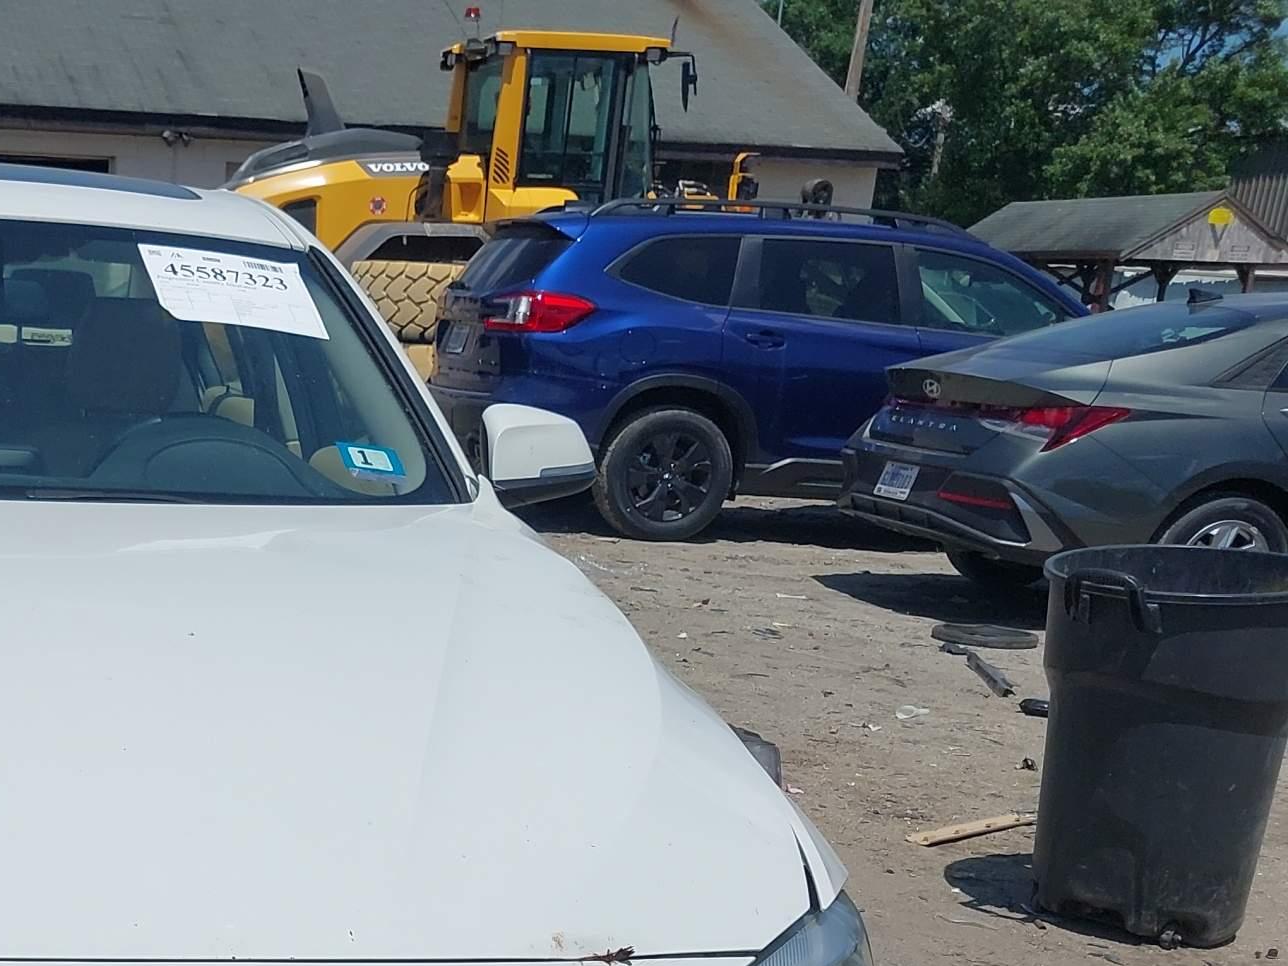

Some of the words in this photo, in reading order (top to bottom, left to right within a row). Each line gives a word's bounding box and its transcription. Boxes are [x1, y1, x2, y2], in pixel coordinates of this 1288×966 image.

[367, 162, 430, 173] VOLVO
[164, 262, 289, 292] 45587323
[357, 449, 374, 466] 1
